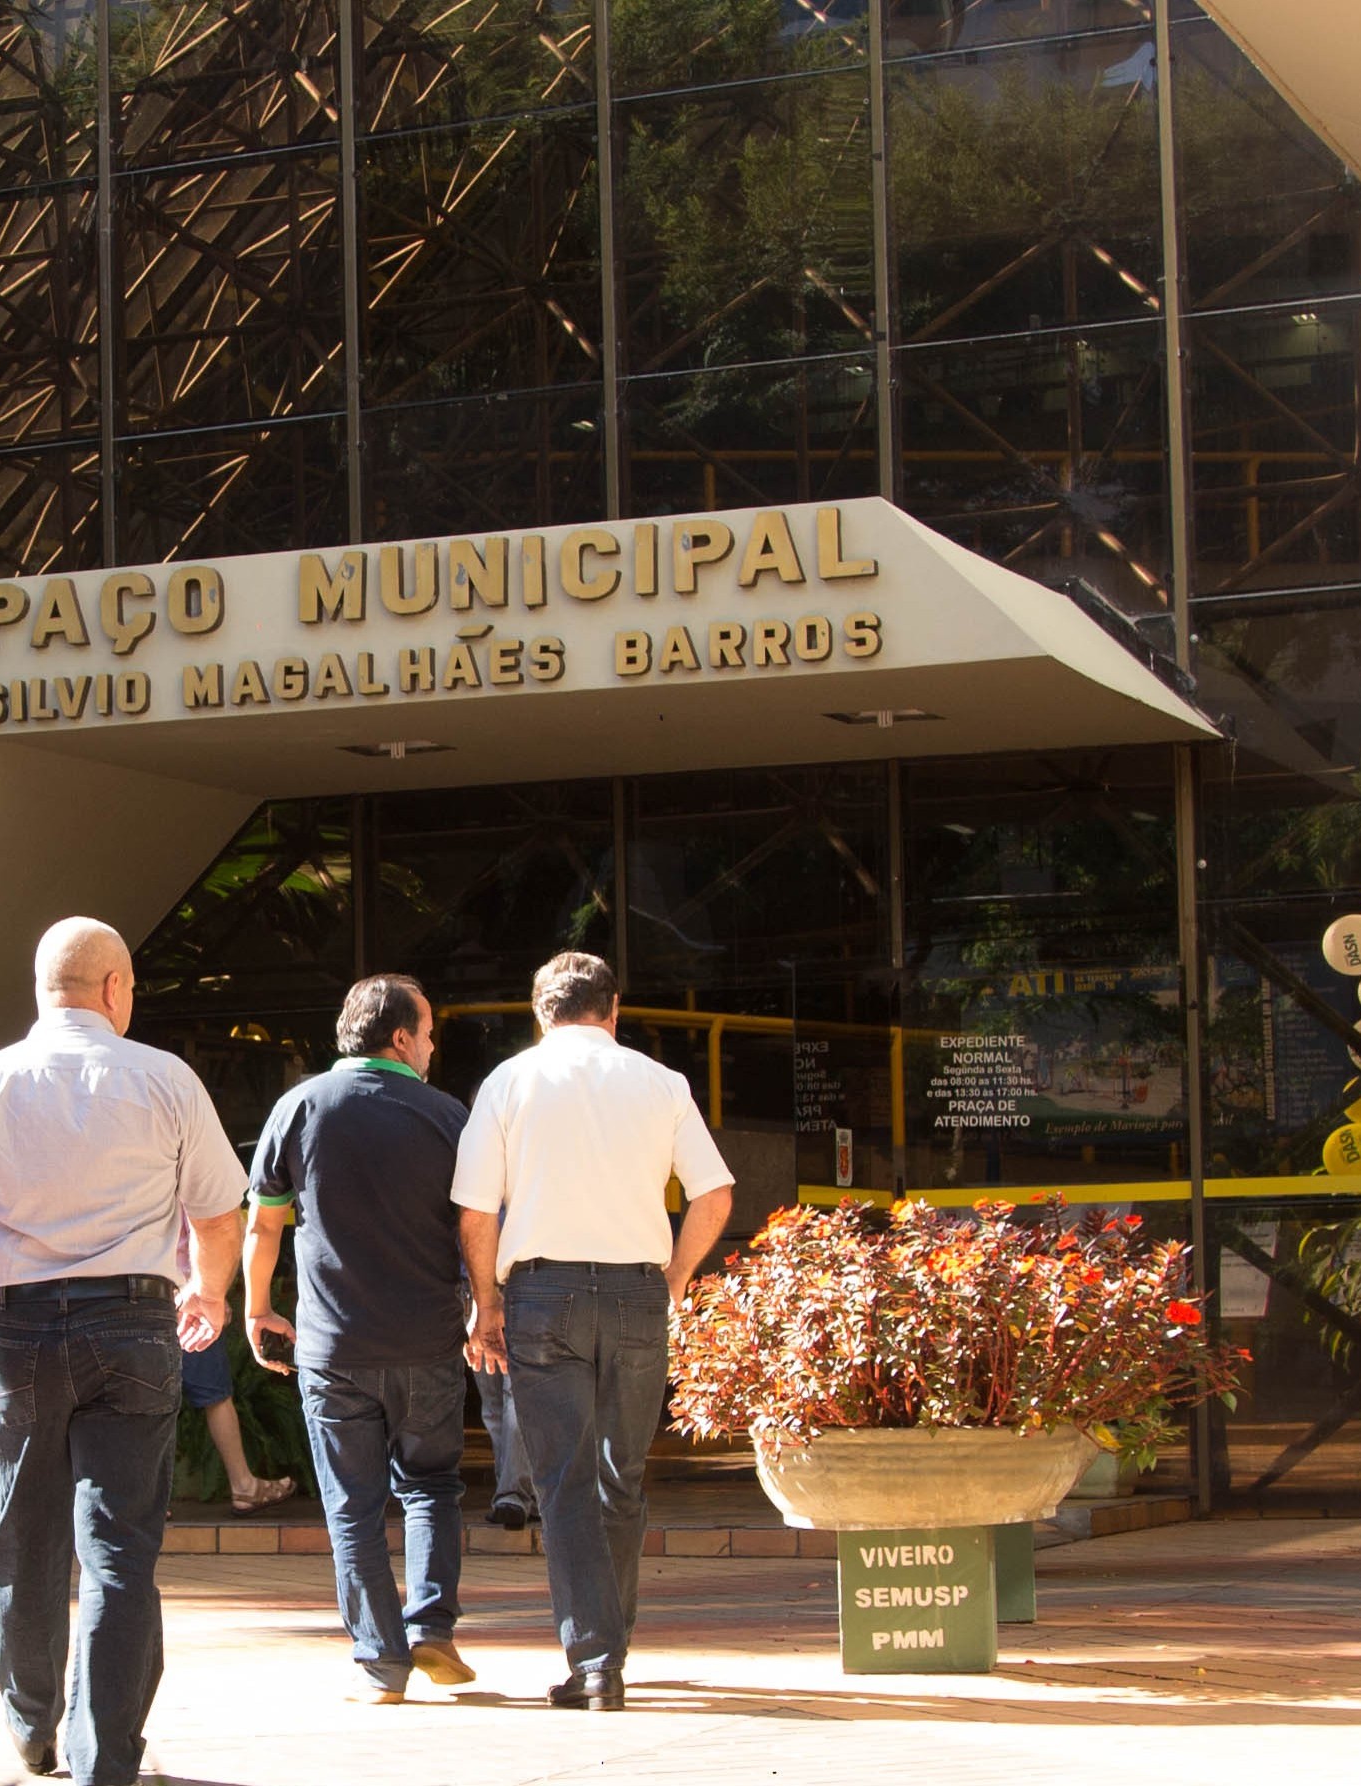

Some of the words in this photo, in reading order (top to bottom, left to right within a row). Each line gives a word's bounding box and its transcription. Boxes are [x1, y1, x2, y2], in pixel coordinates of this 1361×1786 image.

[297, 507, 879, 623] MUNICIPAL
[182, 625, 565, 708] MAGALHÃES
[615, 612, 881, 676] BARROS
[1343, 934, 1361, 967] DASN
[1008, 969, 1064, 997] ATI
[940, 1036, 1026, 1048] EXPEDIENTE
[953, 1052, 1013, 1064] NORMAL
[943, 1065, 985, 1076] Segunda
[995, 1065, 1022, 1074] Sexta
[931, 1077, 948, 1086] das
[950, 1077, 976, 1086] 08:00
[993, 1076, 1018, 1085] 11:30
[927, 1090, 933, 1098] e
[934, 1088, 952, 1098] das
[955, 1088, 981, 1097] 13:30
[997, 1087, 1022, 1096] 17:00
[949, 1100, 995, 1114] PRAÇA
[998, 1100, 1016, 1111] DE
[934, 1115, 1031, 1128] ATENDIMENTO
[1094, 1121, 1108, 1132] de
[860, 1545, 954, 1569] VIVEIRO
[855, 1585, 969, 1608] SEMUSP
[872, 1629, 944, 1651] PMM
